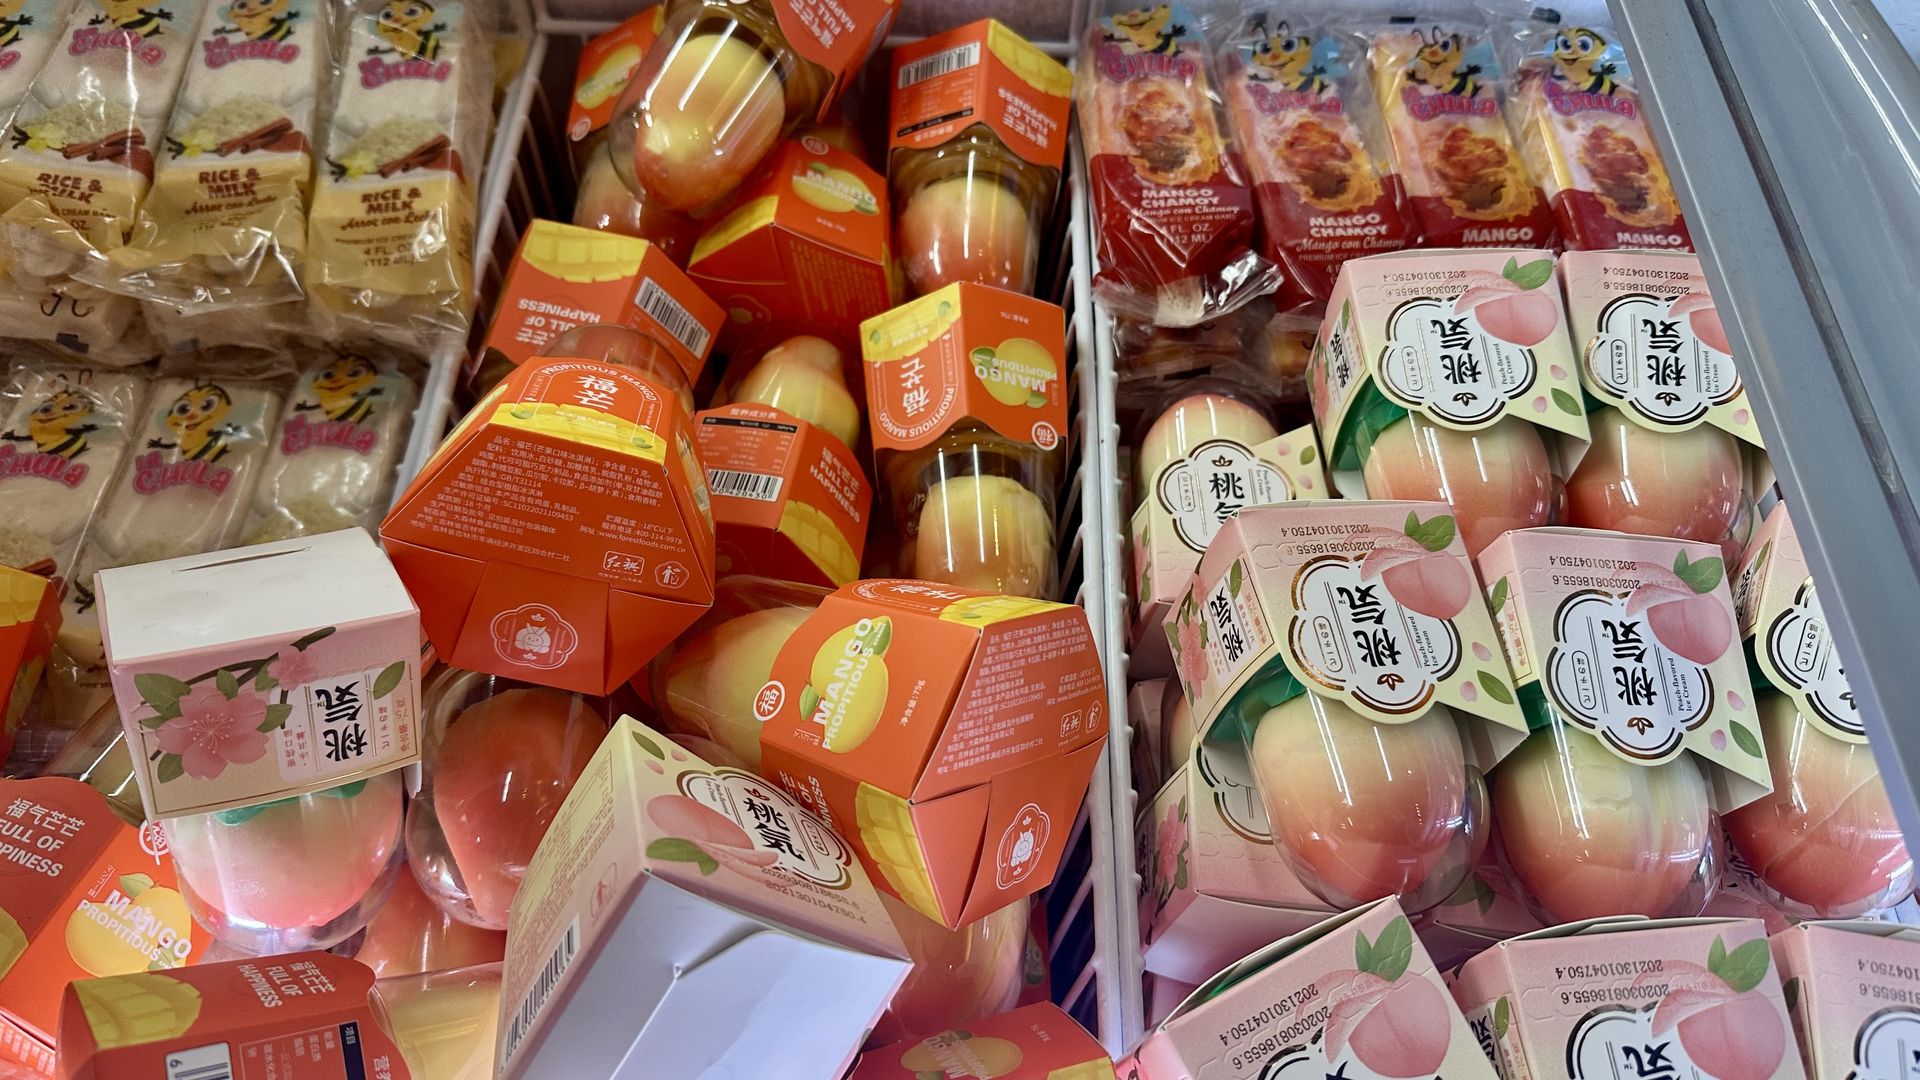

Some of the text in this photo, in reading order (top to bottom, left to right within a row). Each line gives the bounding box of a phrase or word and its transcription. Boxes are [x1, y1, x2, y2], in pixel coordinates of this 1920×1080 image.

[37, 173, 103, 193] RICE &
[198, 167, 262, 185] RICE &
[207, 181, 257, 199] MILK
[361, 187, 421, 204] RICE &
[1141, 188, 1214, 199] MANGO
[366, 200, 415, 216] MILK
[1141, 197, 1220, 209] CHAMOY
[1195, 205, 1240, 214] Chamoy
[1309, 213, 1381, 227] MANGO
[1310, 224, 1388, 238] CHAMOY
[1462, 227, 1534, 242] MANGO
[1616, 231, 1683, 246] MANGO
[1296, 238, 1340, 253] Mango
[1341, 239, 1361, 250] con
[1603, 266, 1690, 281] 202130104750.4
[517, 298, 601, 324] HAPPINESS
[1503, 354, 1513, 374] Cream
[1711, 363, 1720, 383] Cream
[541, 363, 658, 402] PROPITIOUS MANGO
[974, 364, 1047, 394] MANGO
[879, 386, 955, 439] PROPITIOUS MANGO
[281, 420, 381, 456] CHULA
[132, 458, 236, 495] CHULA
[809, 466, 861, 523] HAPPINESS
[1281, 524, 1371, 538] 202130104750.4
[1287, 541, 1377, 556] 202030818655.6
[1549, 555, 1637, 571] 202130104750.4
[1552, 574, 1642, 590] 202030818655.6
[1421, 630, 1436, 655] Cream
[813, 618, 873, 725] MANGO
[1679, 673, 1692, 700] Cream
[758, 689, 780, 715] 福
[822, 647, 874, 750] PROPITIOUS
[6, 797, 86, 838] 福气芒芒
[36, 835, 65, 852] OF
[77, 899, 161, 960] PROPITIOUS
[103, 889, 192, 959] MANGO
[288, 961, 337, 994] 福气芒芒
[1554, 958, 1664, 979] 202130104750.4
[238, 964, 283, 1008] HAPPINESS
[265, 965, 304, 997] FULL OF
[1560, 982, 1670, 1005] 202030818655.6
[1219, 983, 1320, 1047] 202130104750.4
[1232, 1005, 1334, 1070] 202030818655.6
